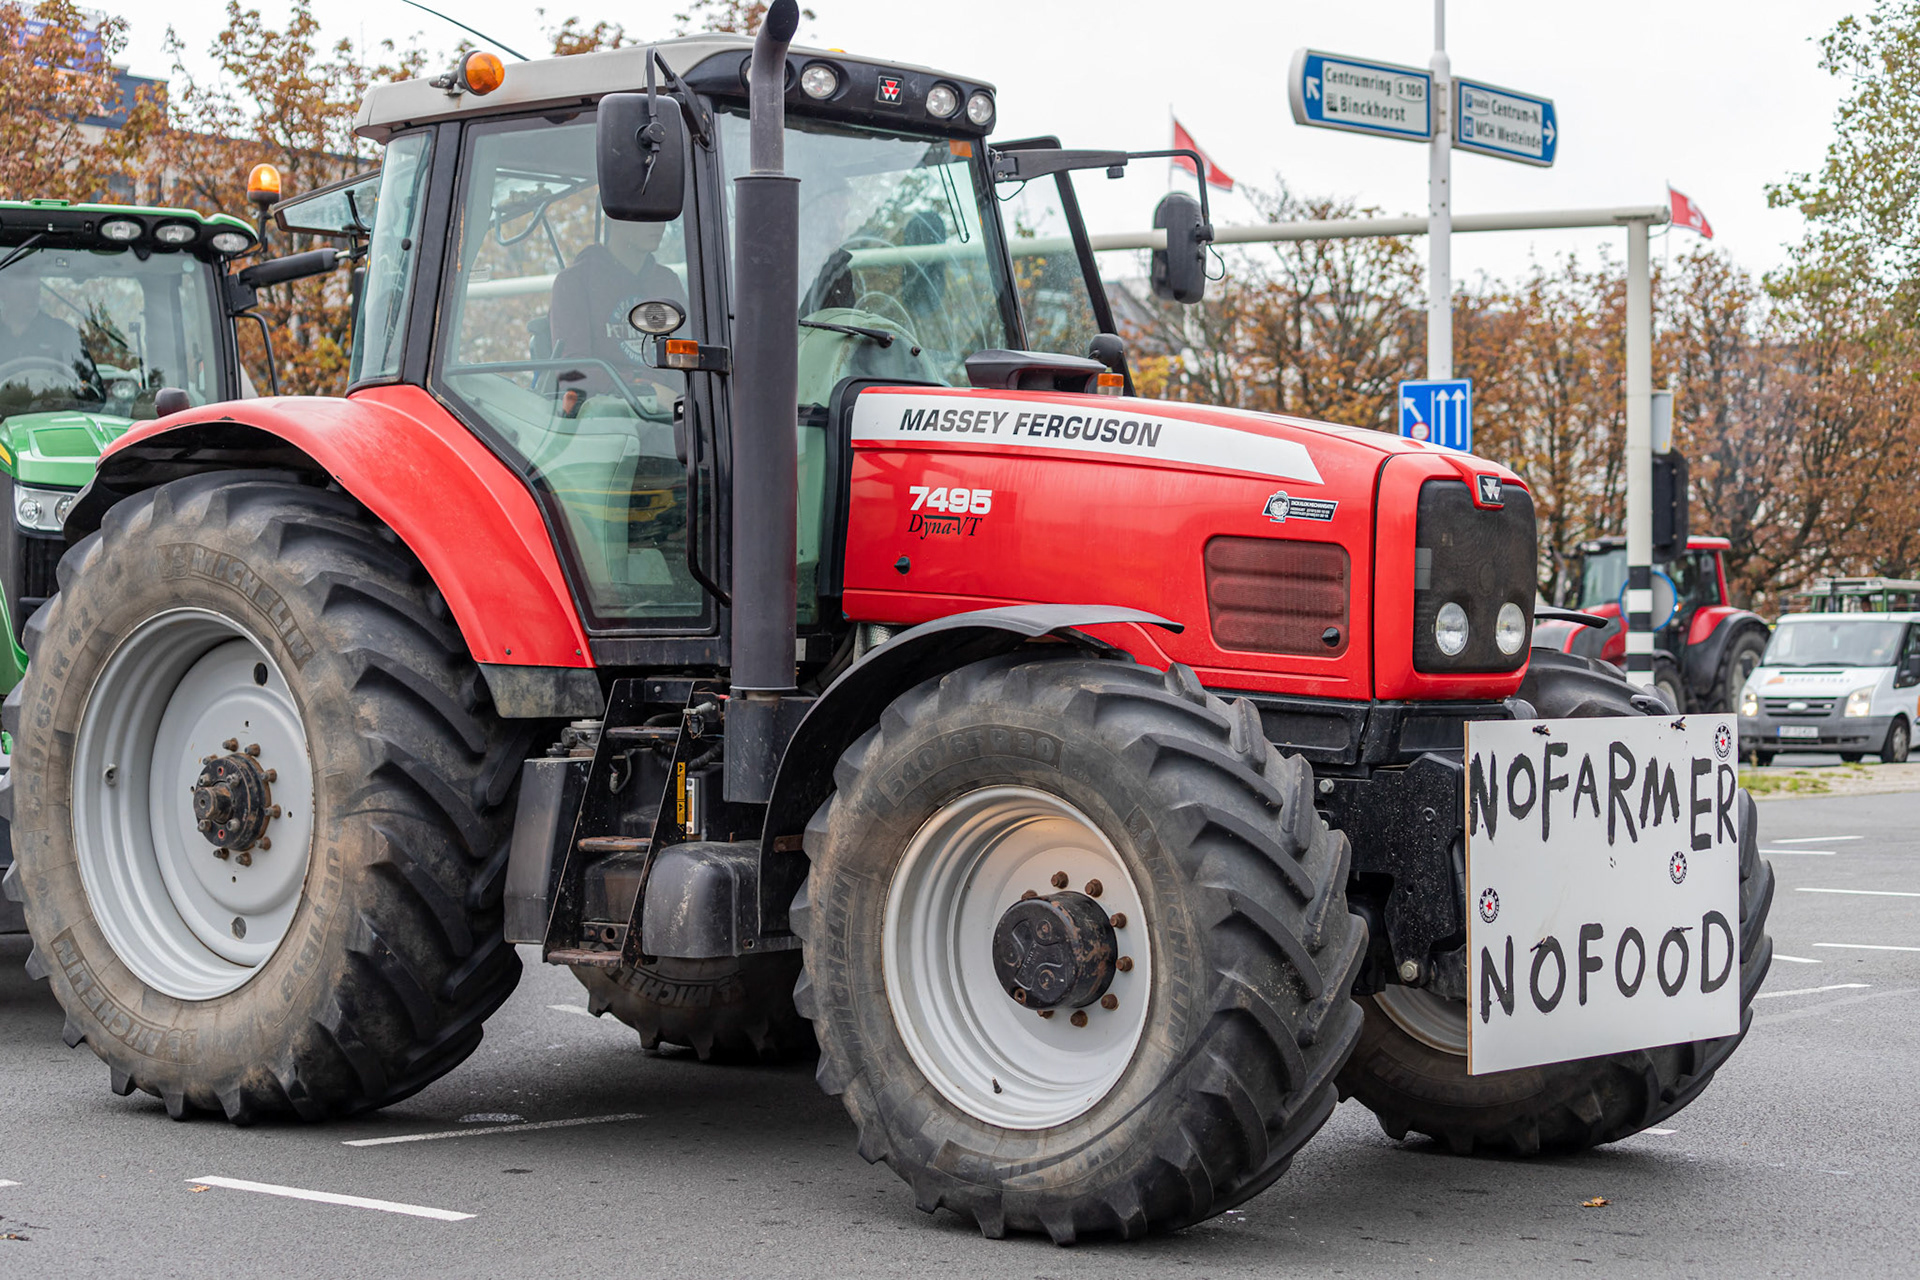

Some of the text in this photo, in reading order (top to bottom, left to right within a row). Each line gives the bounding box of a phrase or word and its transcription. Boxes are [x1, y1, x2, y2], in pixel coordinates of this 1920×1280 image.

[1325, 67, 1391, 96] Centrumring
[1406, 83, 1423, 97] 100
[1341, 96, 1406, 122] Binckhorst
[1498, 126, 1541, 149] Westeinde
[899, 408, 1162, 447] MASSEY FERGUSON
[908, 486, 993, 514] 7495
[907, 514, 983, 540] Dyna-VT
[192, 548, 314, 661] MICHELIN
[52, 938, 163, 1055] MICHELIN
